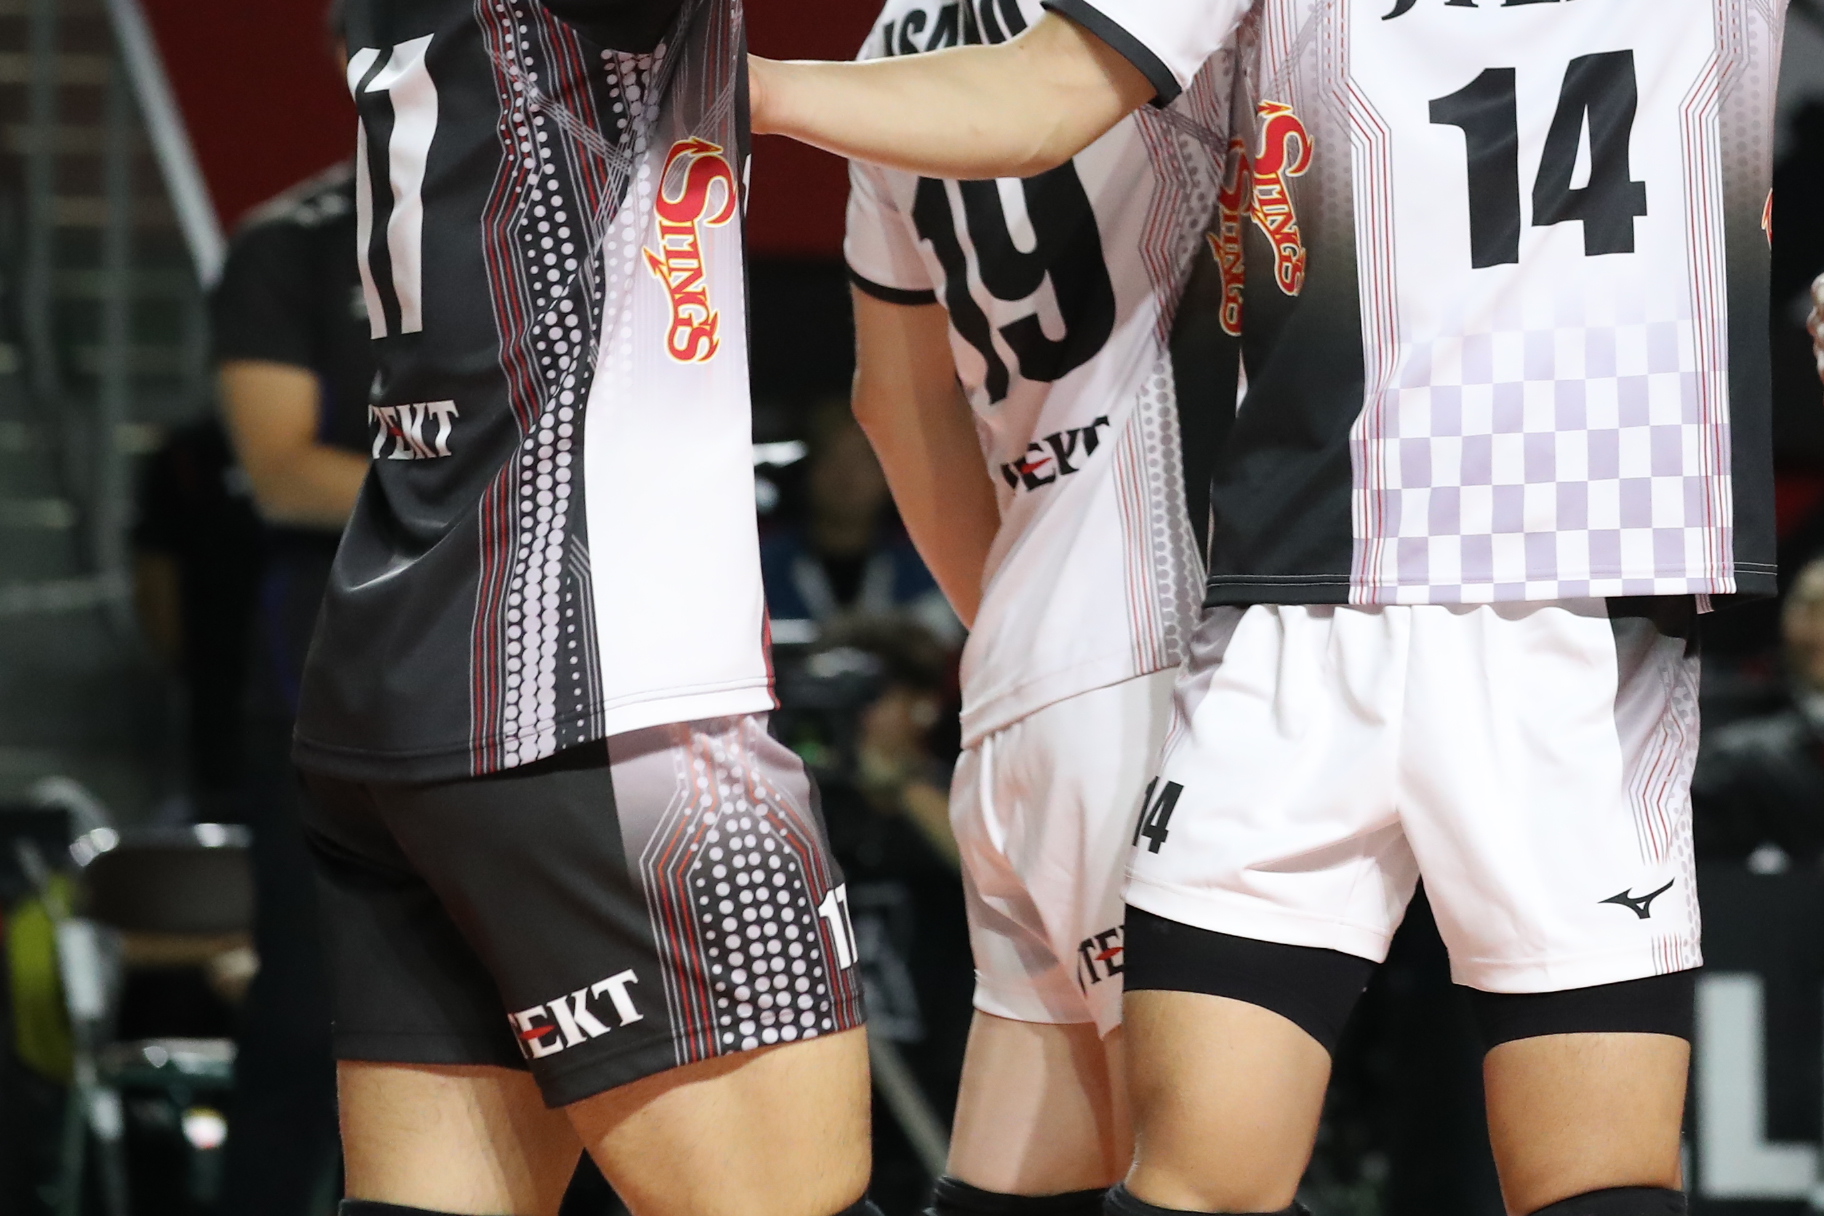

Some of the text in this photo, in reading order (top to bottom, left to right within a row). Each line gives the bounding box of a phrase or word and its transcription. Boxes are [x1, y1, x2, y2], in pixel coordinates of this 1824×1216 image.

[642, 136, 740, 364] STINGS
[1427, 48, 1648, 270] 14
[911, 156, 1117, 406] 19
[507, 968, 645, 1060] EKT
